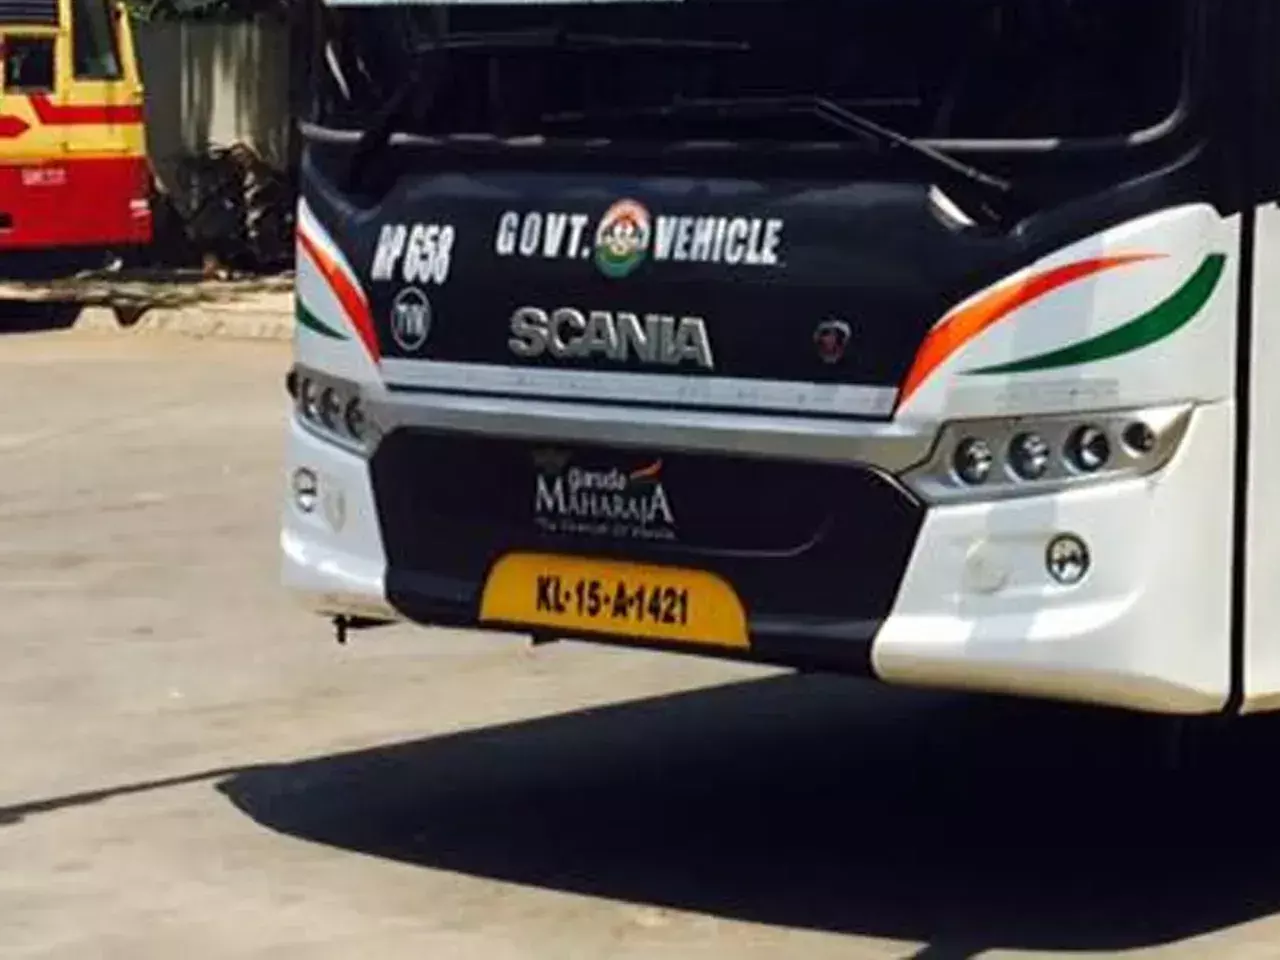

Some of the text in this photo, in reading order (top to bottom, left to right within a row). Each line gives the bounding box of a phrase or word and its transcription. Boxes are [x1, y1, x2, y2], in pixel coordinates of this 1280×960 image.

[403, 222, 455, 286] 658
[496, 211, 784, 267] GOVT. VEHICLE
[508, 305, 715, 371] SCANIA
